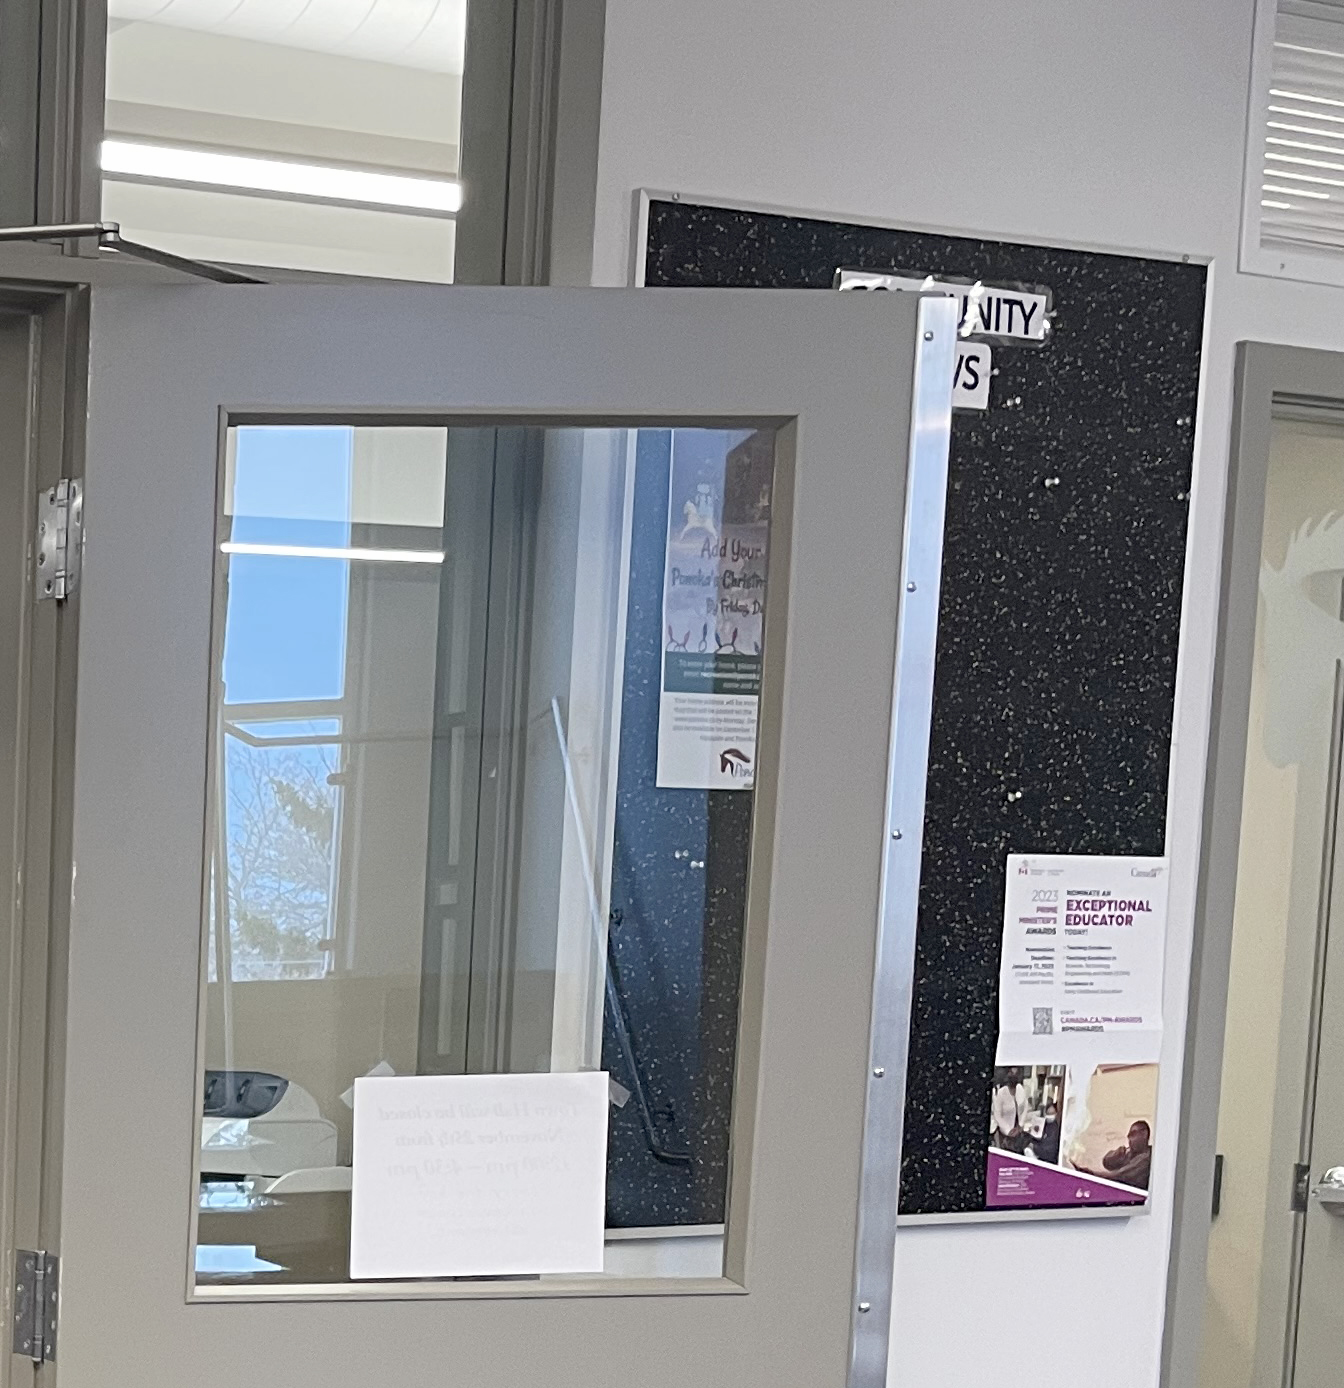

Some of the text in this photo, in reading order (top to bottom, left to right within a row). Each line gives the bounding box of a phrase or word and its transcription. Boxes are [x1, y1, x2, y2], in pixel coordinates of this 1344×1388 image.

[700, 536, 762, 562] Add Your
[1032, 889, 1059, 902] 2023
[1066, 900, 1153, 912] EXCEPTIONAL
[1064, 913, 1134, 926] EDUCATOR
